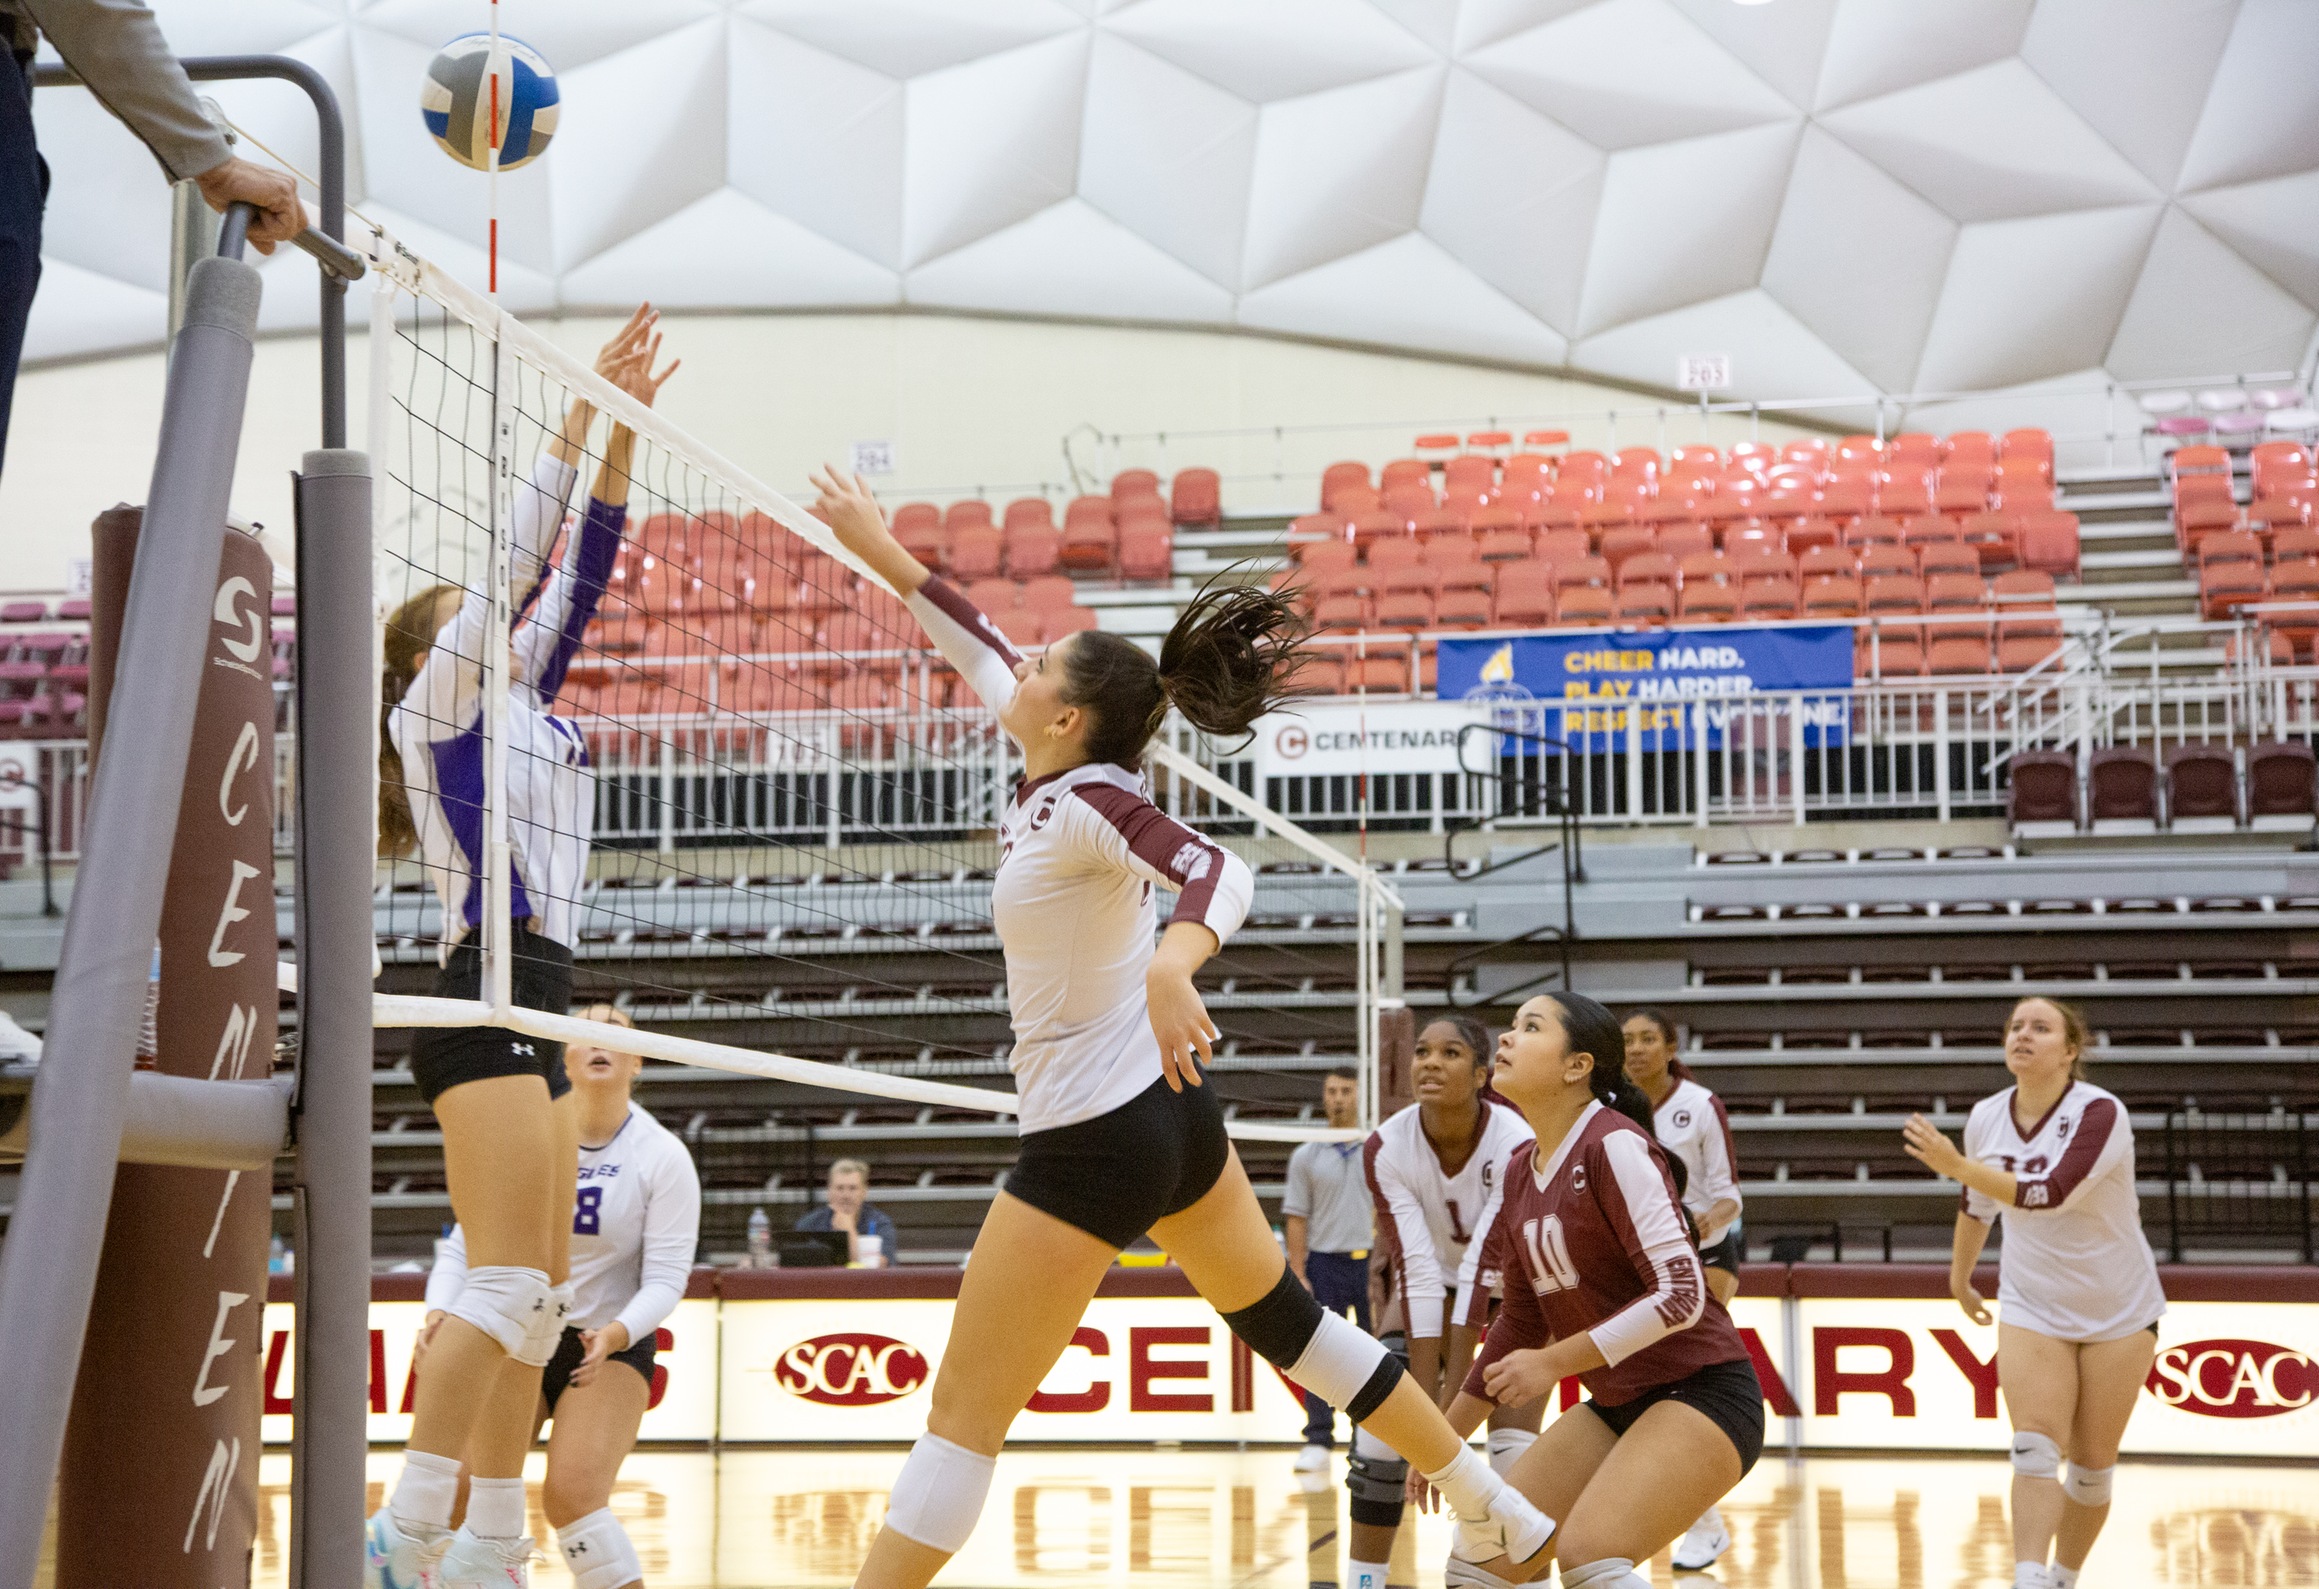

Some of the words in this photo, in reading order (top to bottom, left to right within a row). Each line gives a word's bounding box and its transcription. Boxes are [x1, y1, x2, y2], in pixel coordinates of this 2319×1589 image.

[1564, 650, 1654, 673] CHEER
[1658, 646, 1746, 670] HARD.
[1564, 680, 1633, 699] PLAY
[1638, 675, 1760, 699] HARDER.
[577, 1164, 621, 1180] GLES
[573, 1186, 603, 1236] 8
[1446, 1199, 1472, 1246] 1
[1523, 1213, 1580, 1297] 10
[783, 1342, 918, 1396] SCAC
[2154, 1348, 2312, 1408] SCAC
